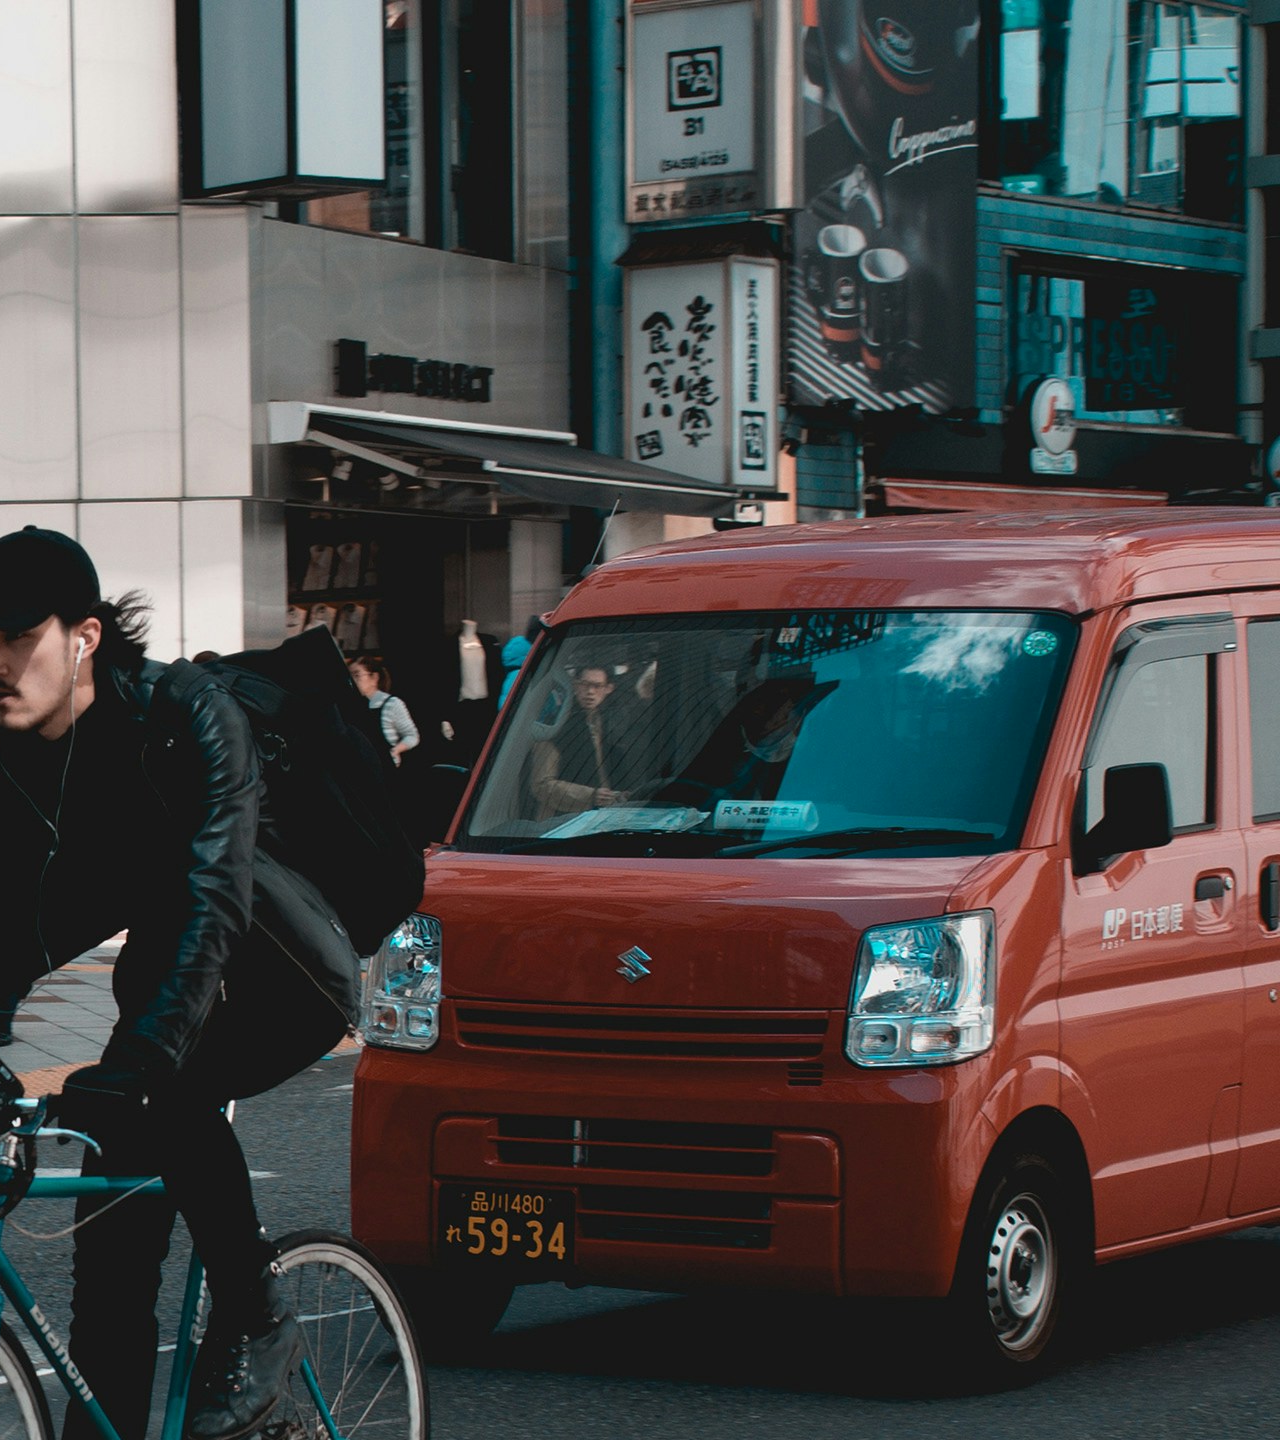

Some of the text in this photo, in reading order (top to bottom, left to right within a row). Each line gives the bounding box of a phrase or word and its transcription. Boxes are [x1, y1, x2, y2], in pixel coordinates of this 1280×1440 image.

[683, 117, 705, 136] B1
[640, 311, 675, 419] 食べたい
[1131, 903, 1185, 940] 日本郵便
[1101, 939, 1125, 951] POST
[445, 1216, 567, 1261] れ 59-34
[29, 1303, 94, 1402] Bianchi
